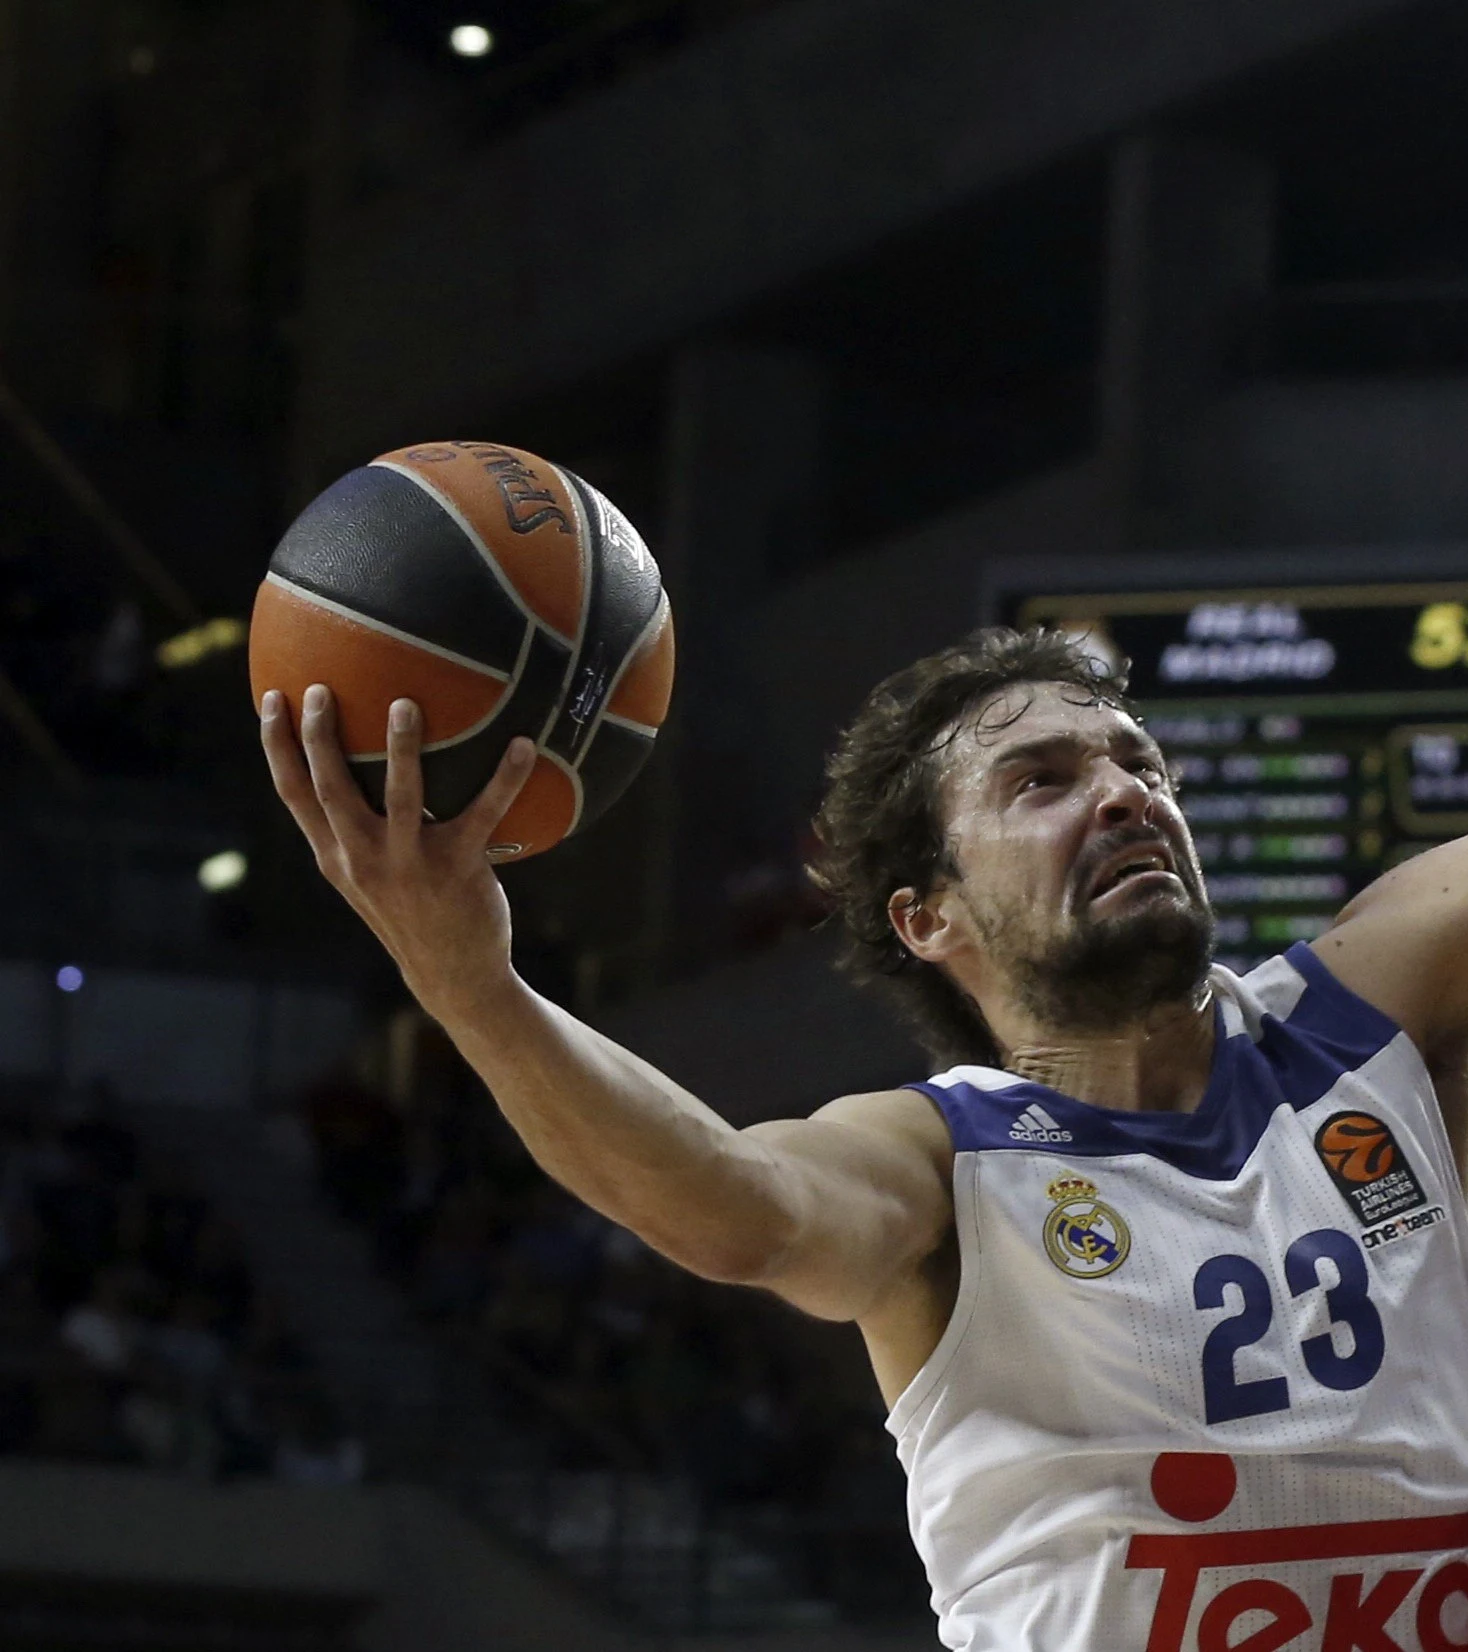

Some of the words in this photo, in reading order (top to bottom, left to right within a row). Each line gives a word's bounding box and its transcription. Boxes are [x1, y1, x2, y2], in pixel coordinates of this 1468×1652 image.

[1009, 1128, 1073, 1143] adidas
[1351, 1170, 1409, 1200] TURKISH
[1360, 1180, 1414, 1210] AIRLINES
[1193, 1228, 1385, 1425] 23
